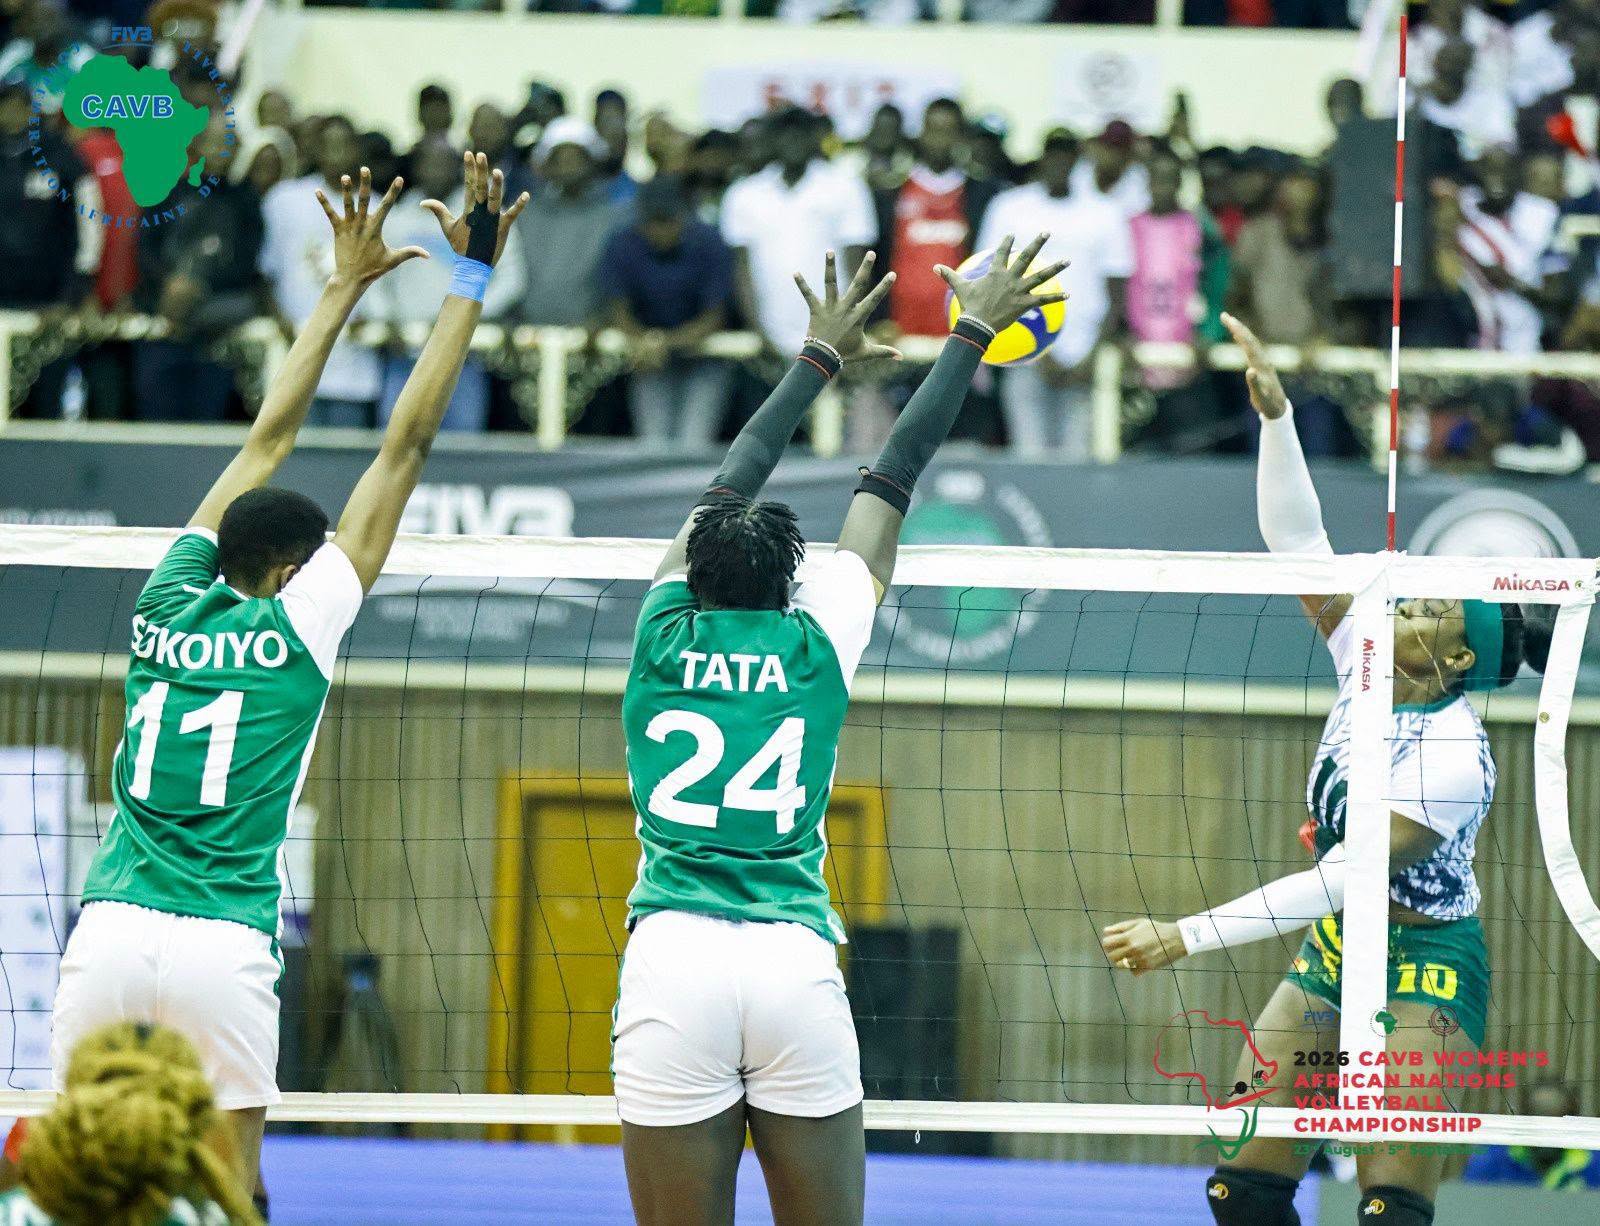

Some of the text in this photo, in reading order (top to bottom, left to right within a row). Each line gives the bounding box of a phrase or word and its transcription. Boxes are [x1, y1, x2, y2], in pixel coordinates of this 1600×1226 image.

[680, 650, 789, 693] TATA
[127, 681, 244, 806] 11
[645, 709, 807, 834] 24
[1396, 962, 1457, 1000] 10
